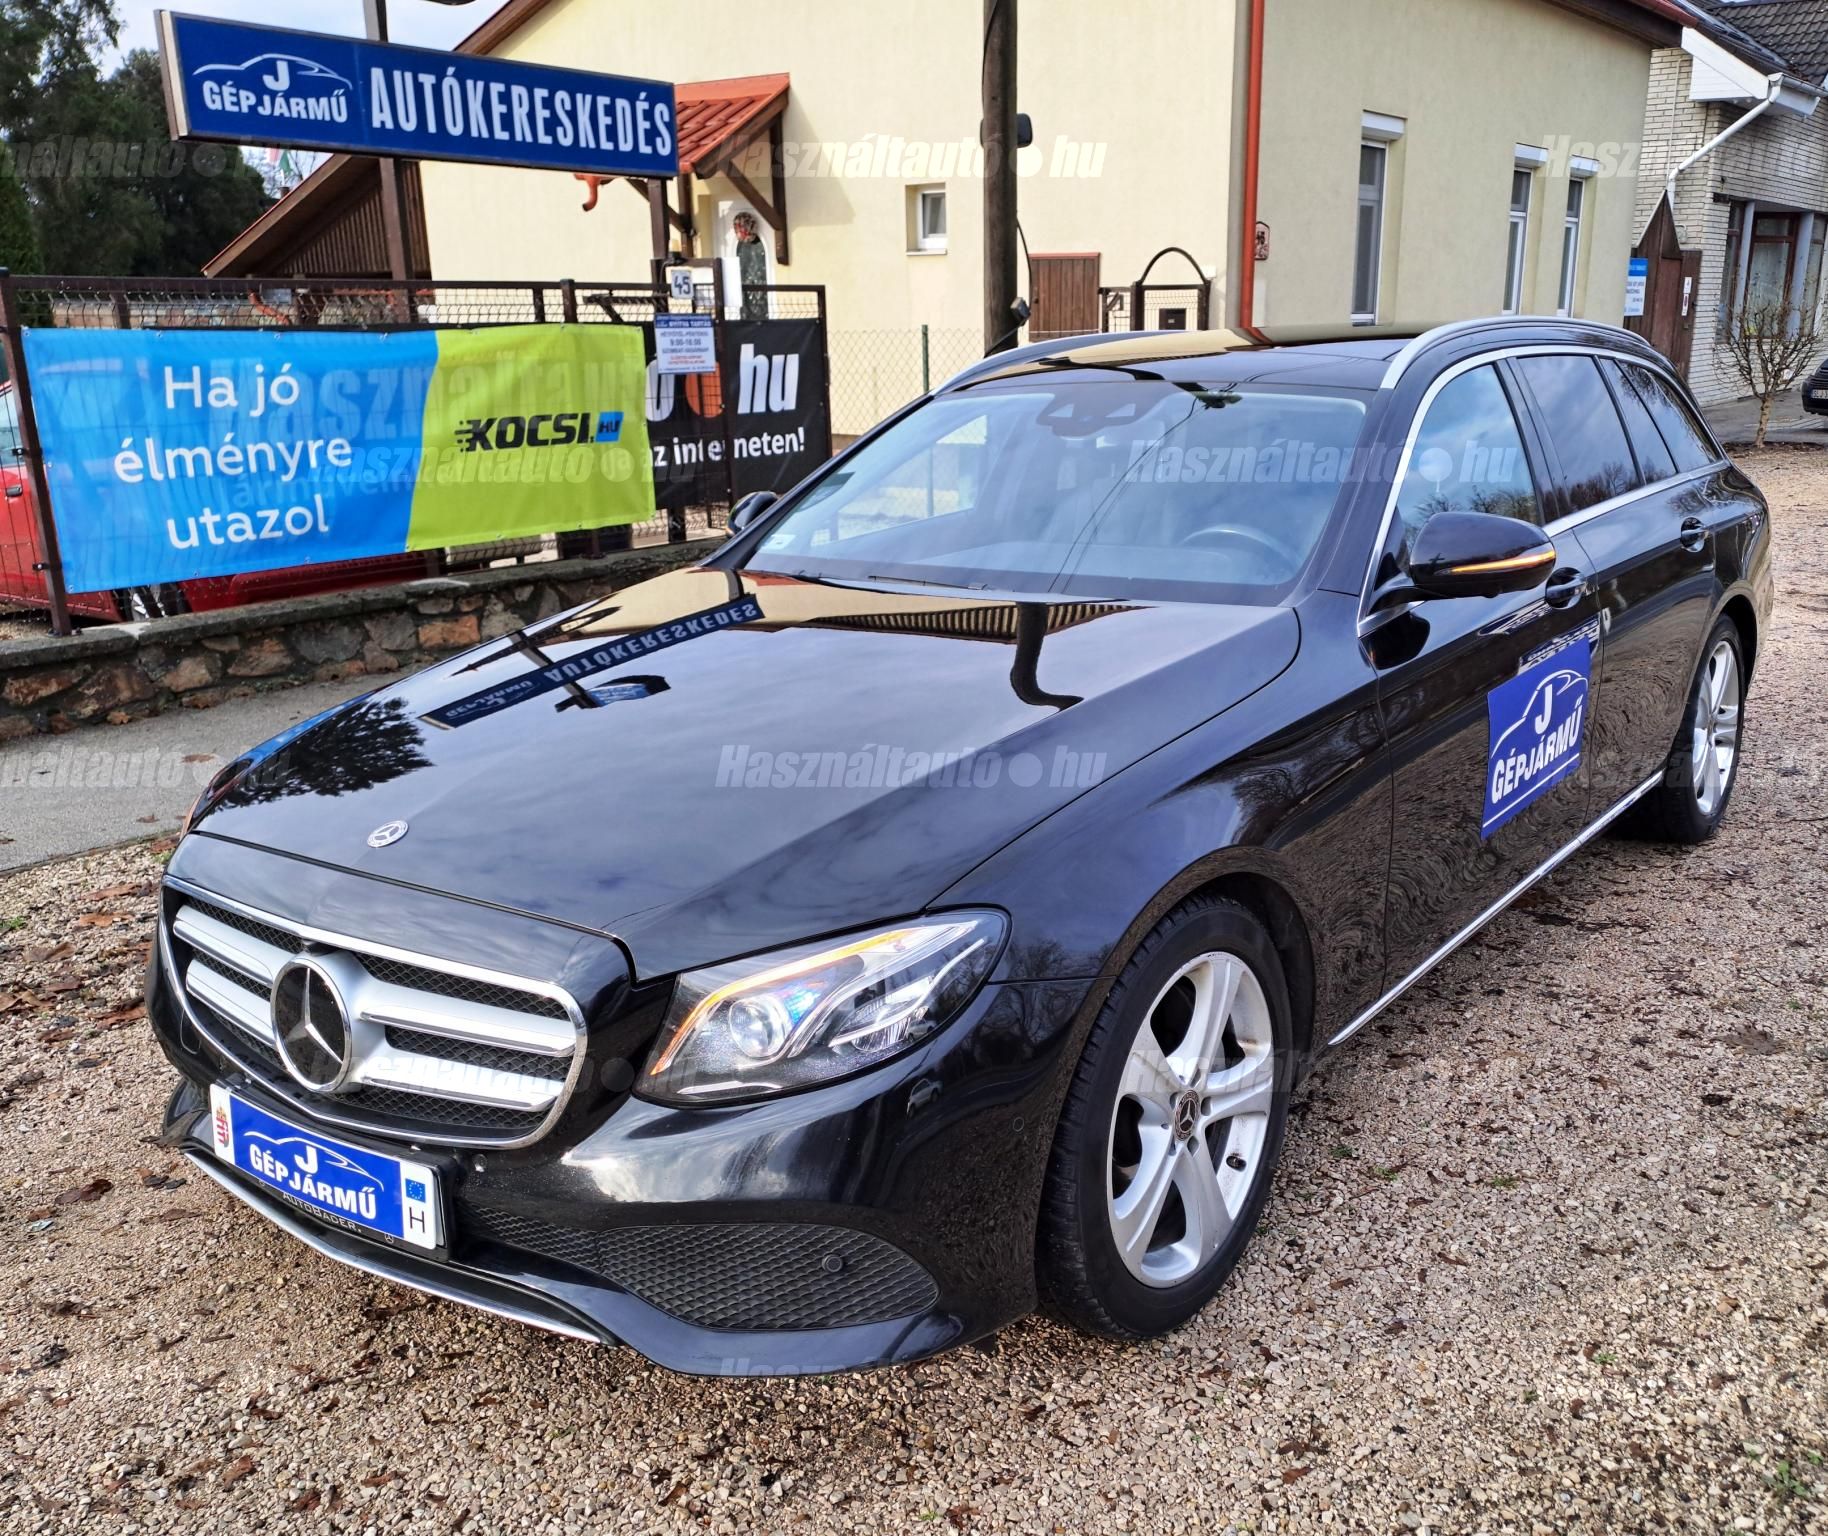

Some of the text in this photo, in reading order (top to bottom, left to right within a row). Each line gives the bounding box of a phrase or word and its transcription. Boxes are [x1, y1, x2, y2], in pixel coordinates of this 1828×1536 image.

[262, 60, 290, 91] J
[202, 80, 348, 123] GÉPJÁRMŰ
[370, 66, 672, 157] AUTÓKERESKEDÉS
[673, 274, 692, 296] 45
[164, 363, 300, 417] Ha jó
[737, 343, 799, 414] hu
[114, 432, 352, 483] élményre
[672, 427, 805, 465] inteneten!
[166, 493, 330, 549] utazol
[1534, 684, 1553, 735] J
[1491, 694, 1584, 804] GÉPJÁRMŰ
[249, 1143, 377, 1220] GÉPJÁRMŰ
[293, 1145, 318, 1174] J
[408, 1206, 426, 1234] H
